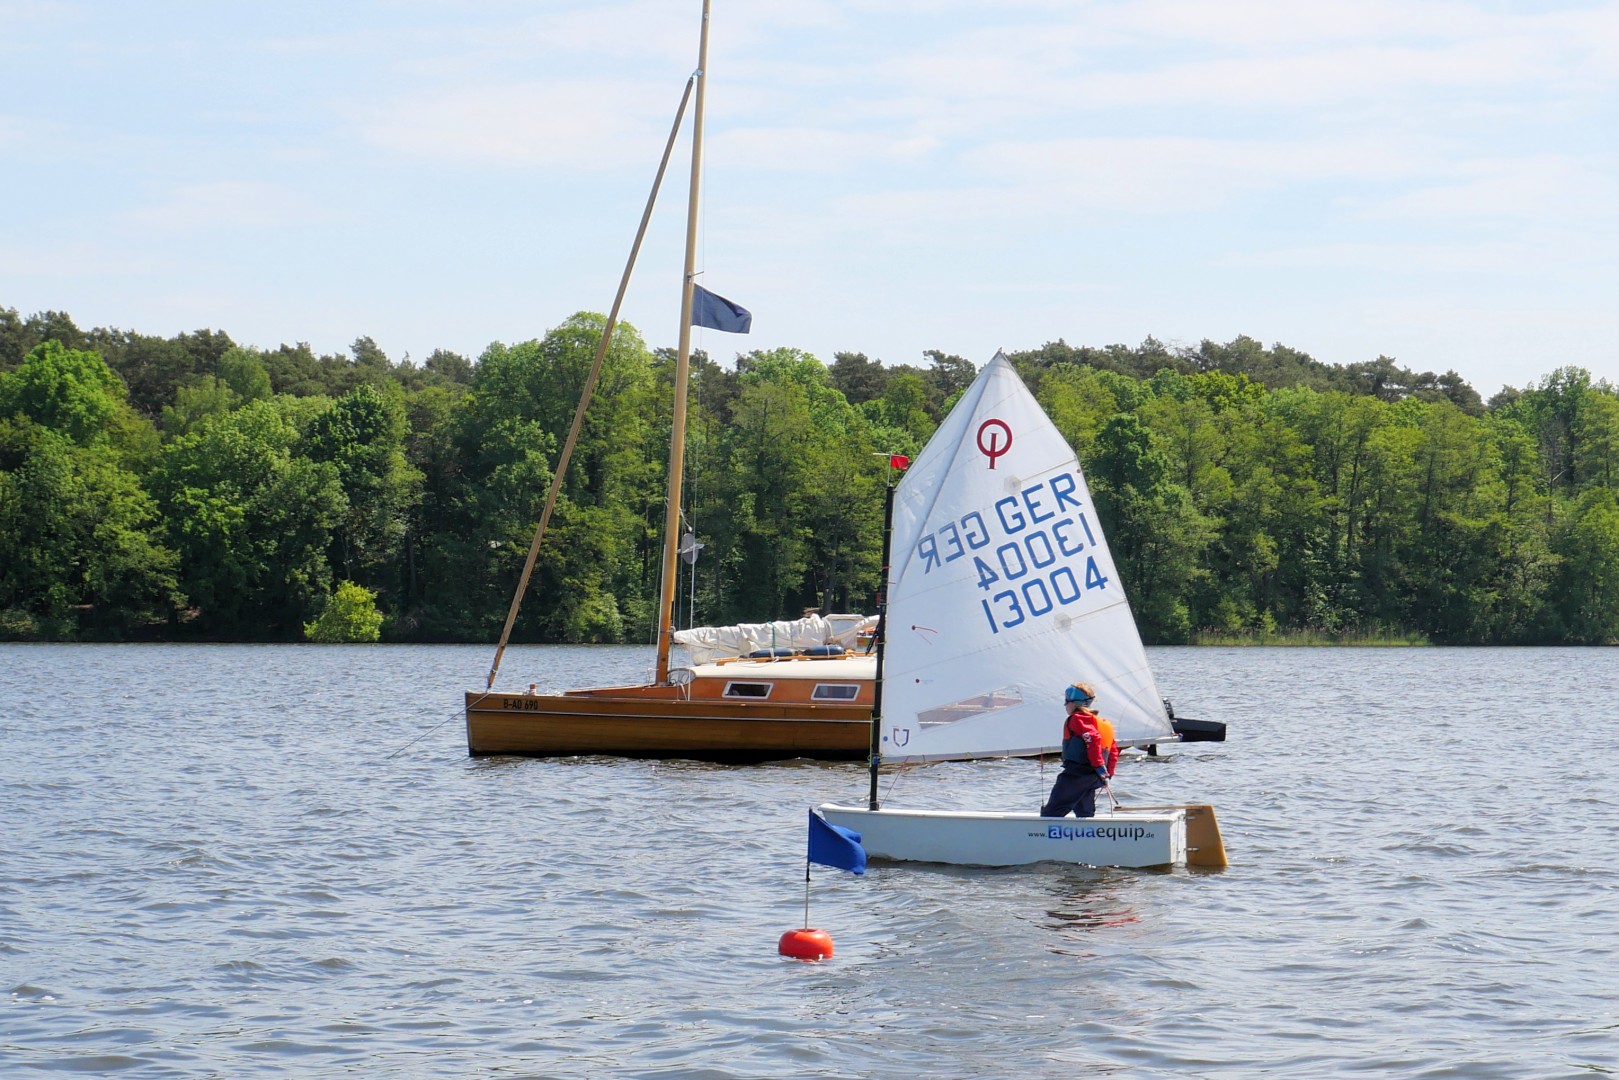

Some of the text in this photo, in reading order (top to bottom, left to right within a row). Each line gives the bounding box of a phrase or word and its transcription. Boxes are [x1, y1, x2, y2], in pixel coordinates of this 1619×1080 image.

[995, 472, 1082, 535] GER
[981, 555, 1109, 634] 13004
[524, 700, 538, 710] 690
[1028, 824, 1155, 841] www.aquaequip.de
